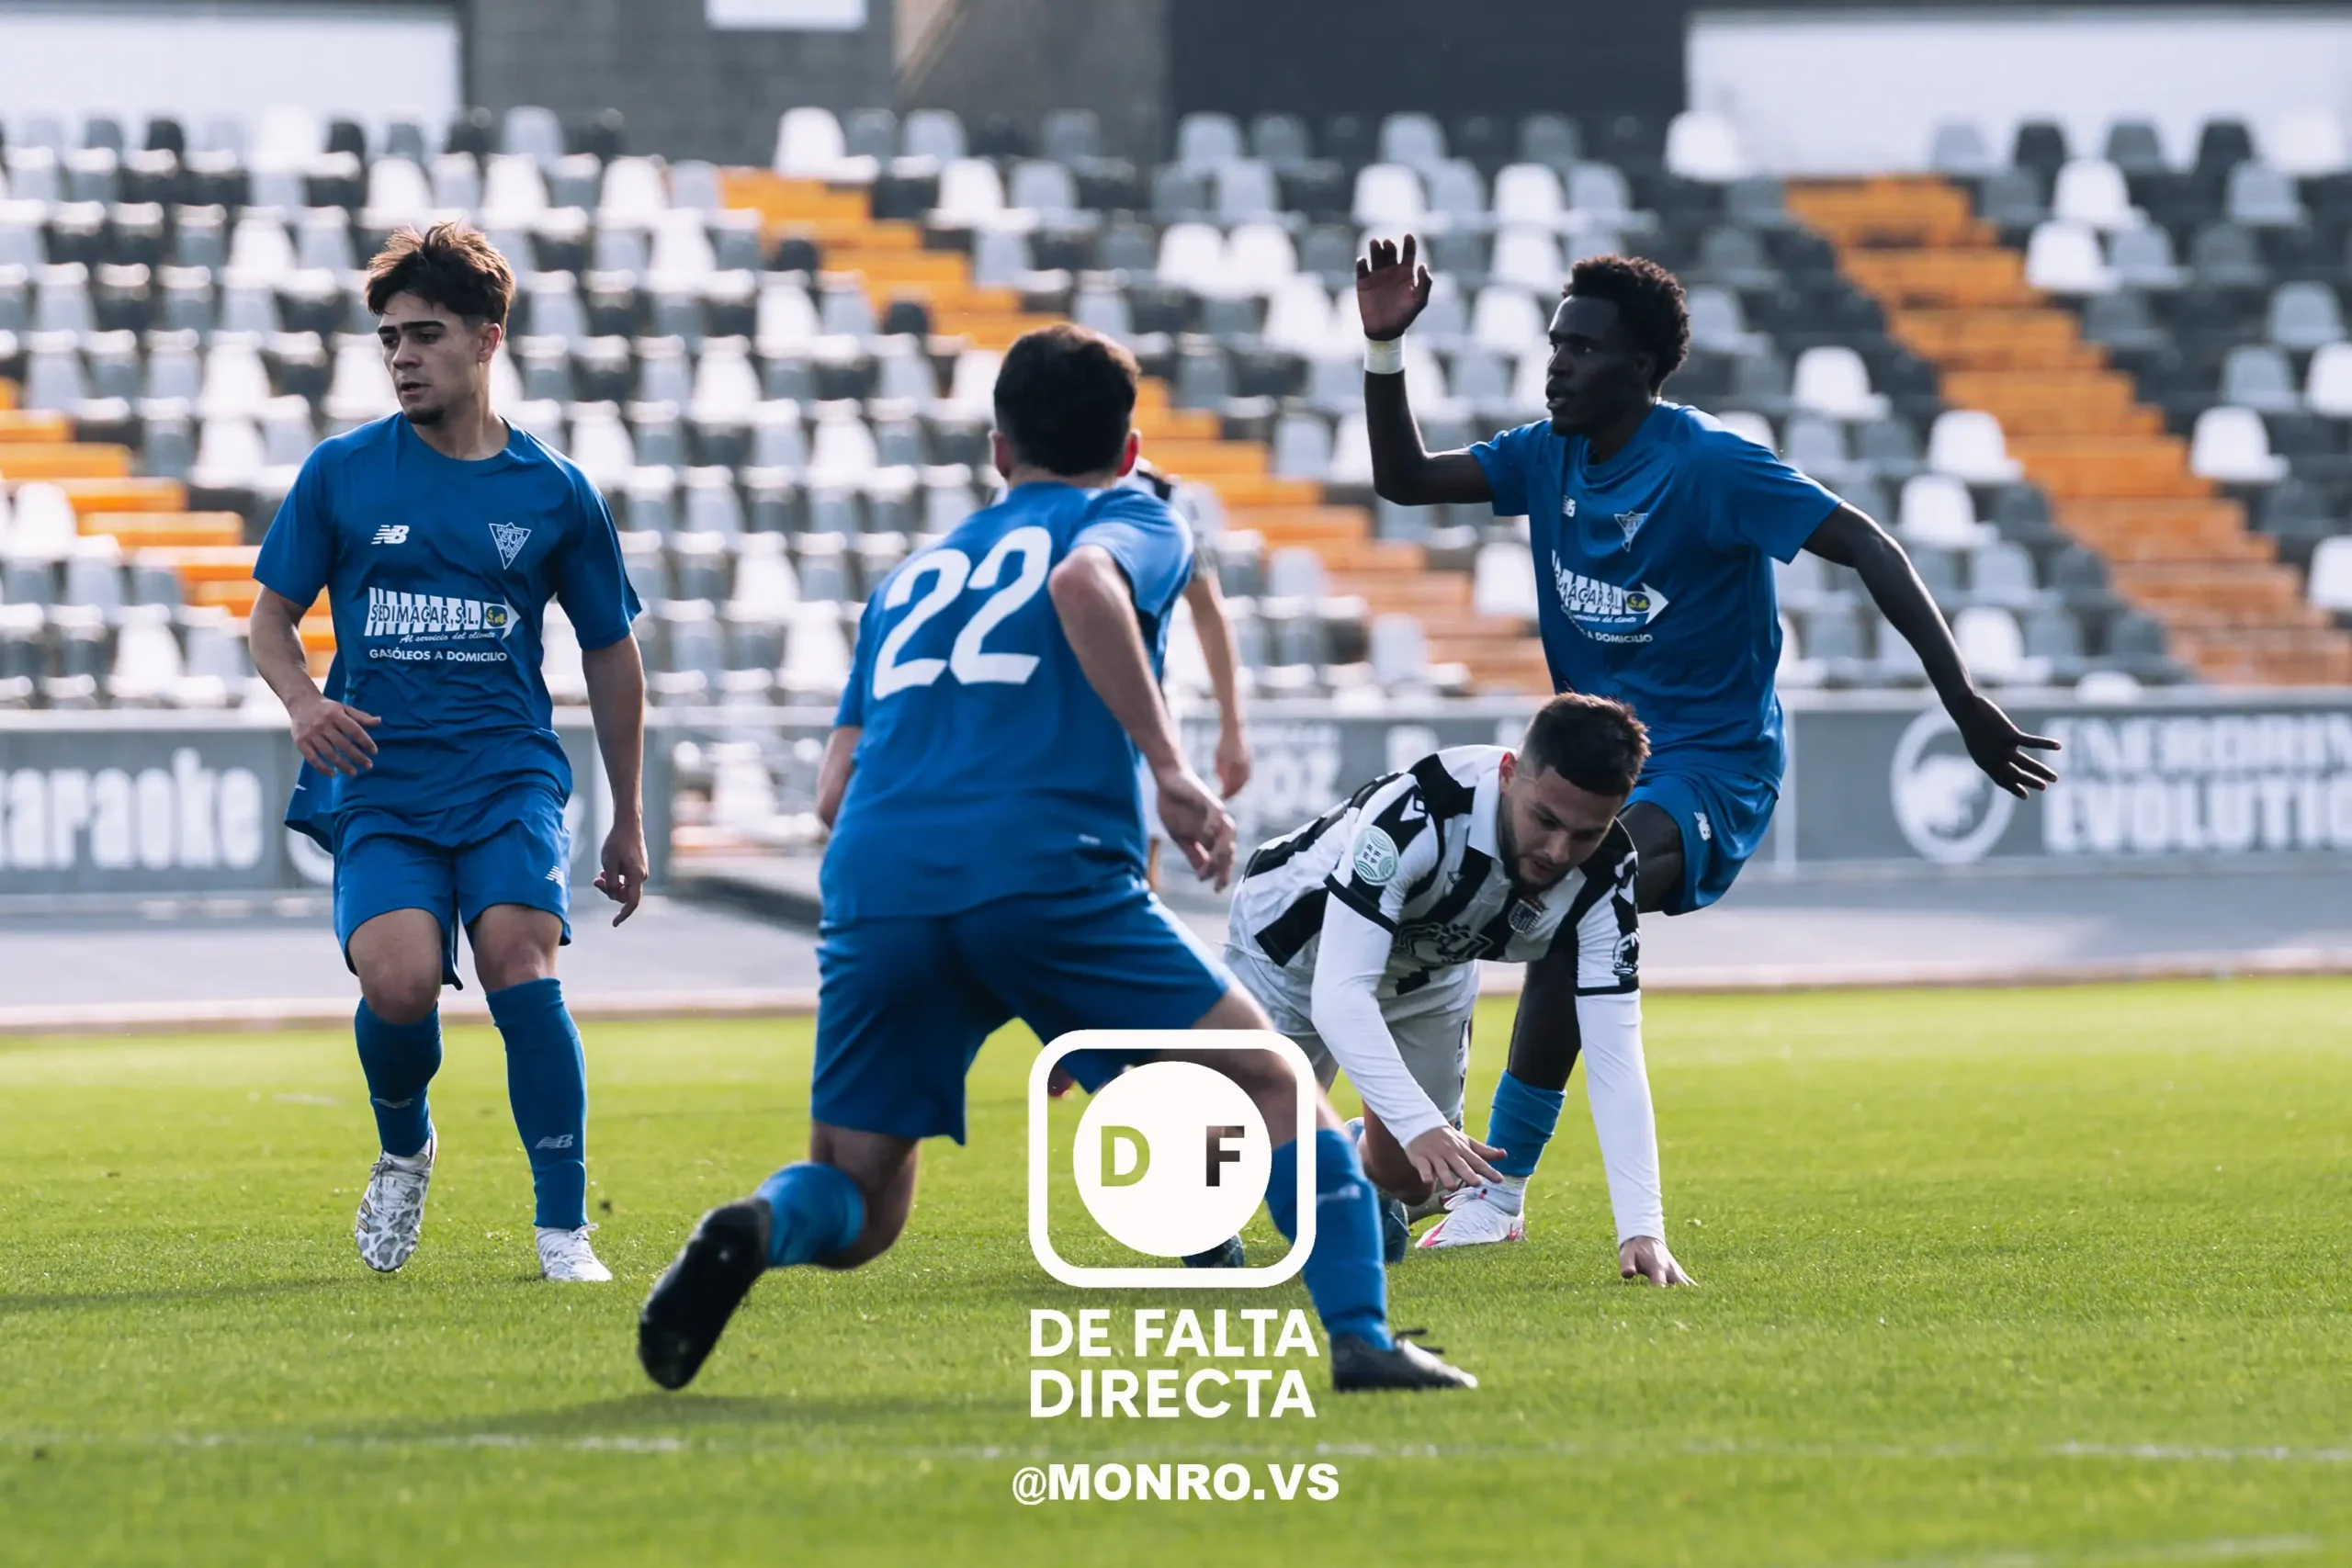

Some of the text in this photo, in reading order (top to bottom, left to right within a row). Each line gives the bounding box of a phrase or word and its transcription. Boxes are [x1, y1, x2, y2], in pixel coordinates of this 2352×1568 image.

[368, 647, 508, 661] GASÓLEOS A DOMICILIO
[873, 526, 1052, 701] 22
[0, 747, 264, 870] araoke
